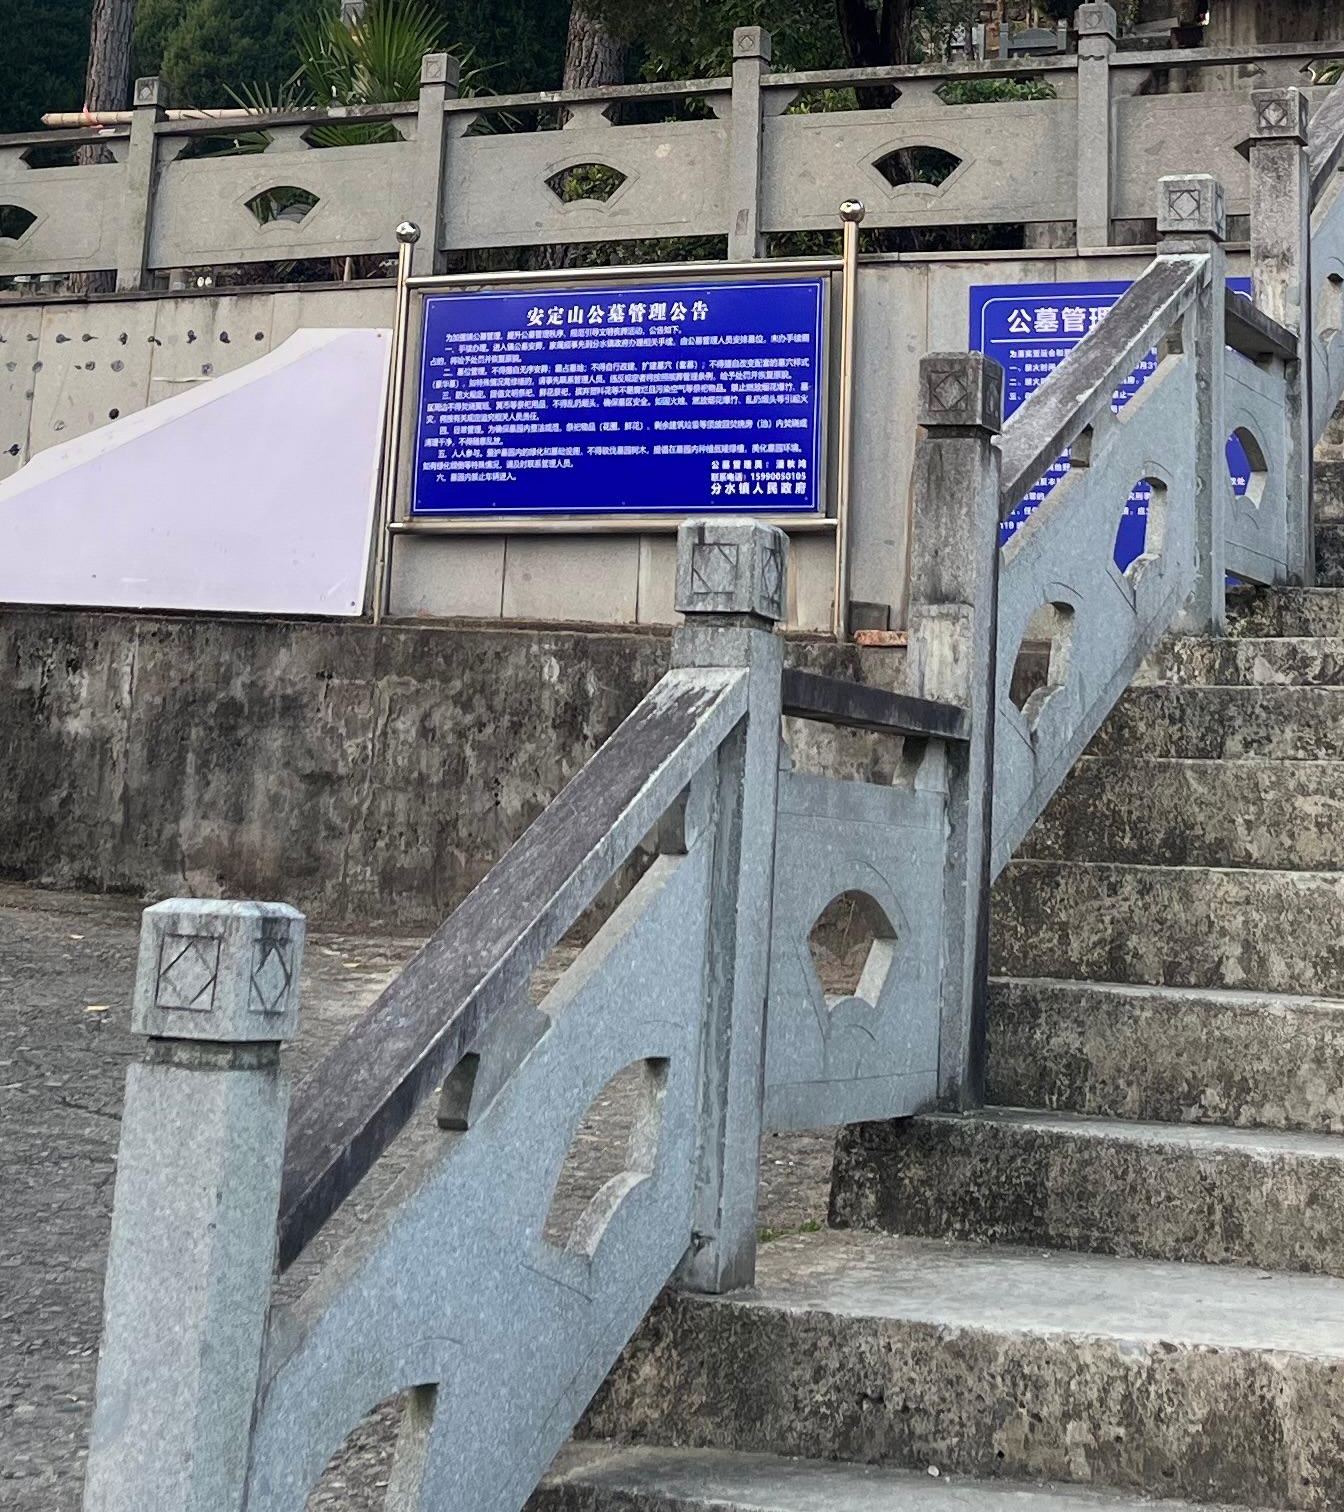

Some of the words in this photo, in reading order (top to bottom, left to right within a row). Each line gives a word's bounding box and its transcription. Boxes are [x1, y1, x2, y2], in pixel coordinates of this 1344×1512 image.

[526, 299, 709, 326] 安定山公墓管理公告
[709, 481, 806, 495] 分水镇人民政府
